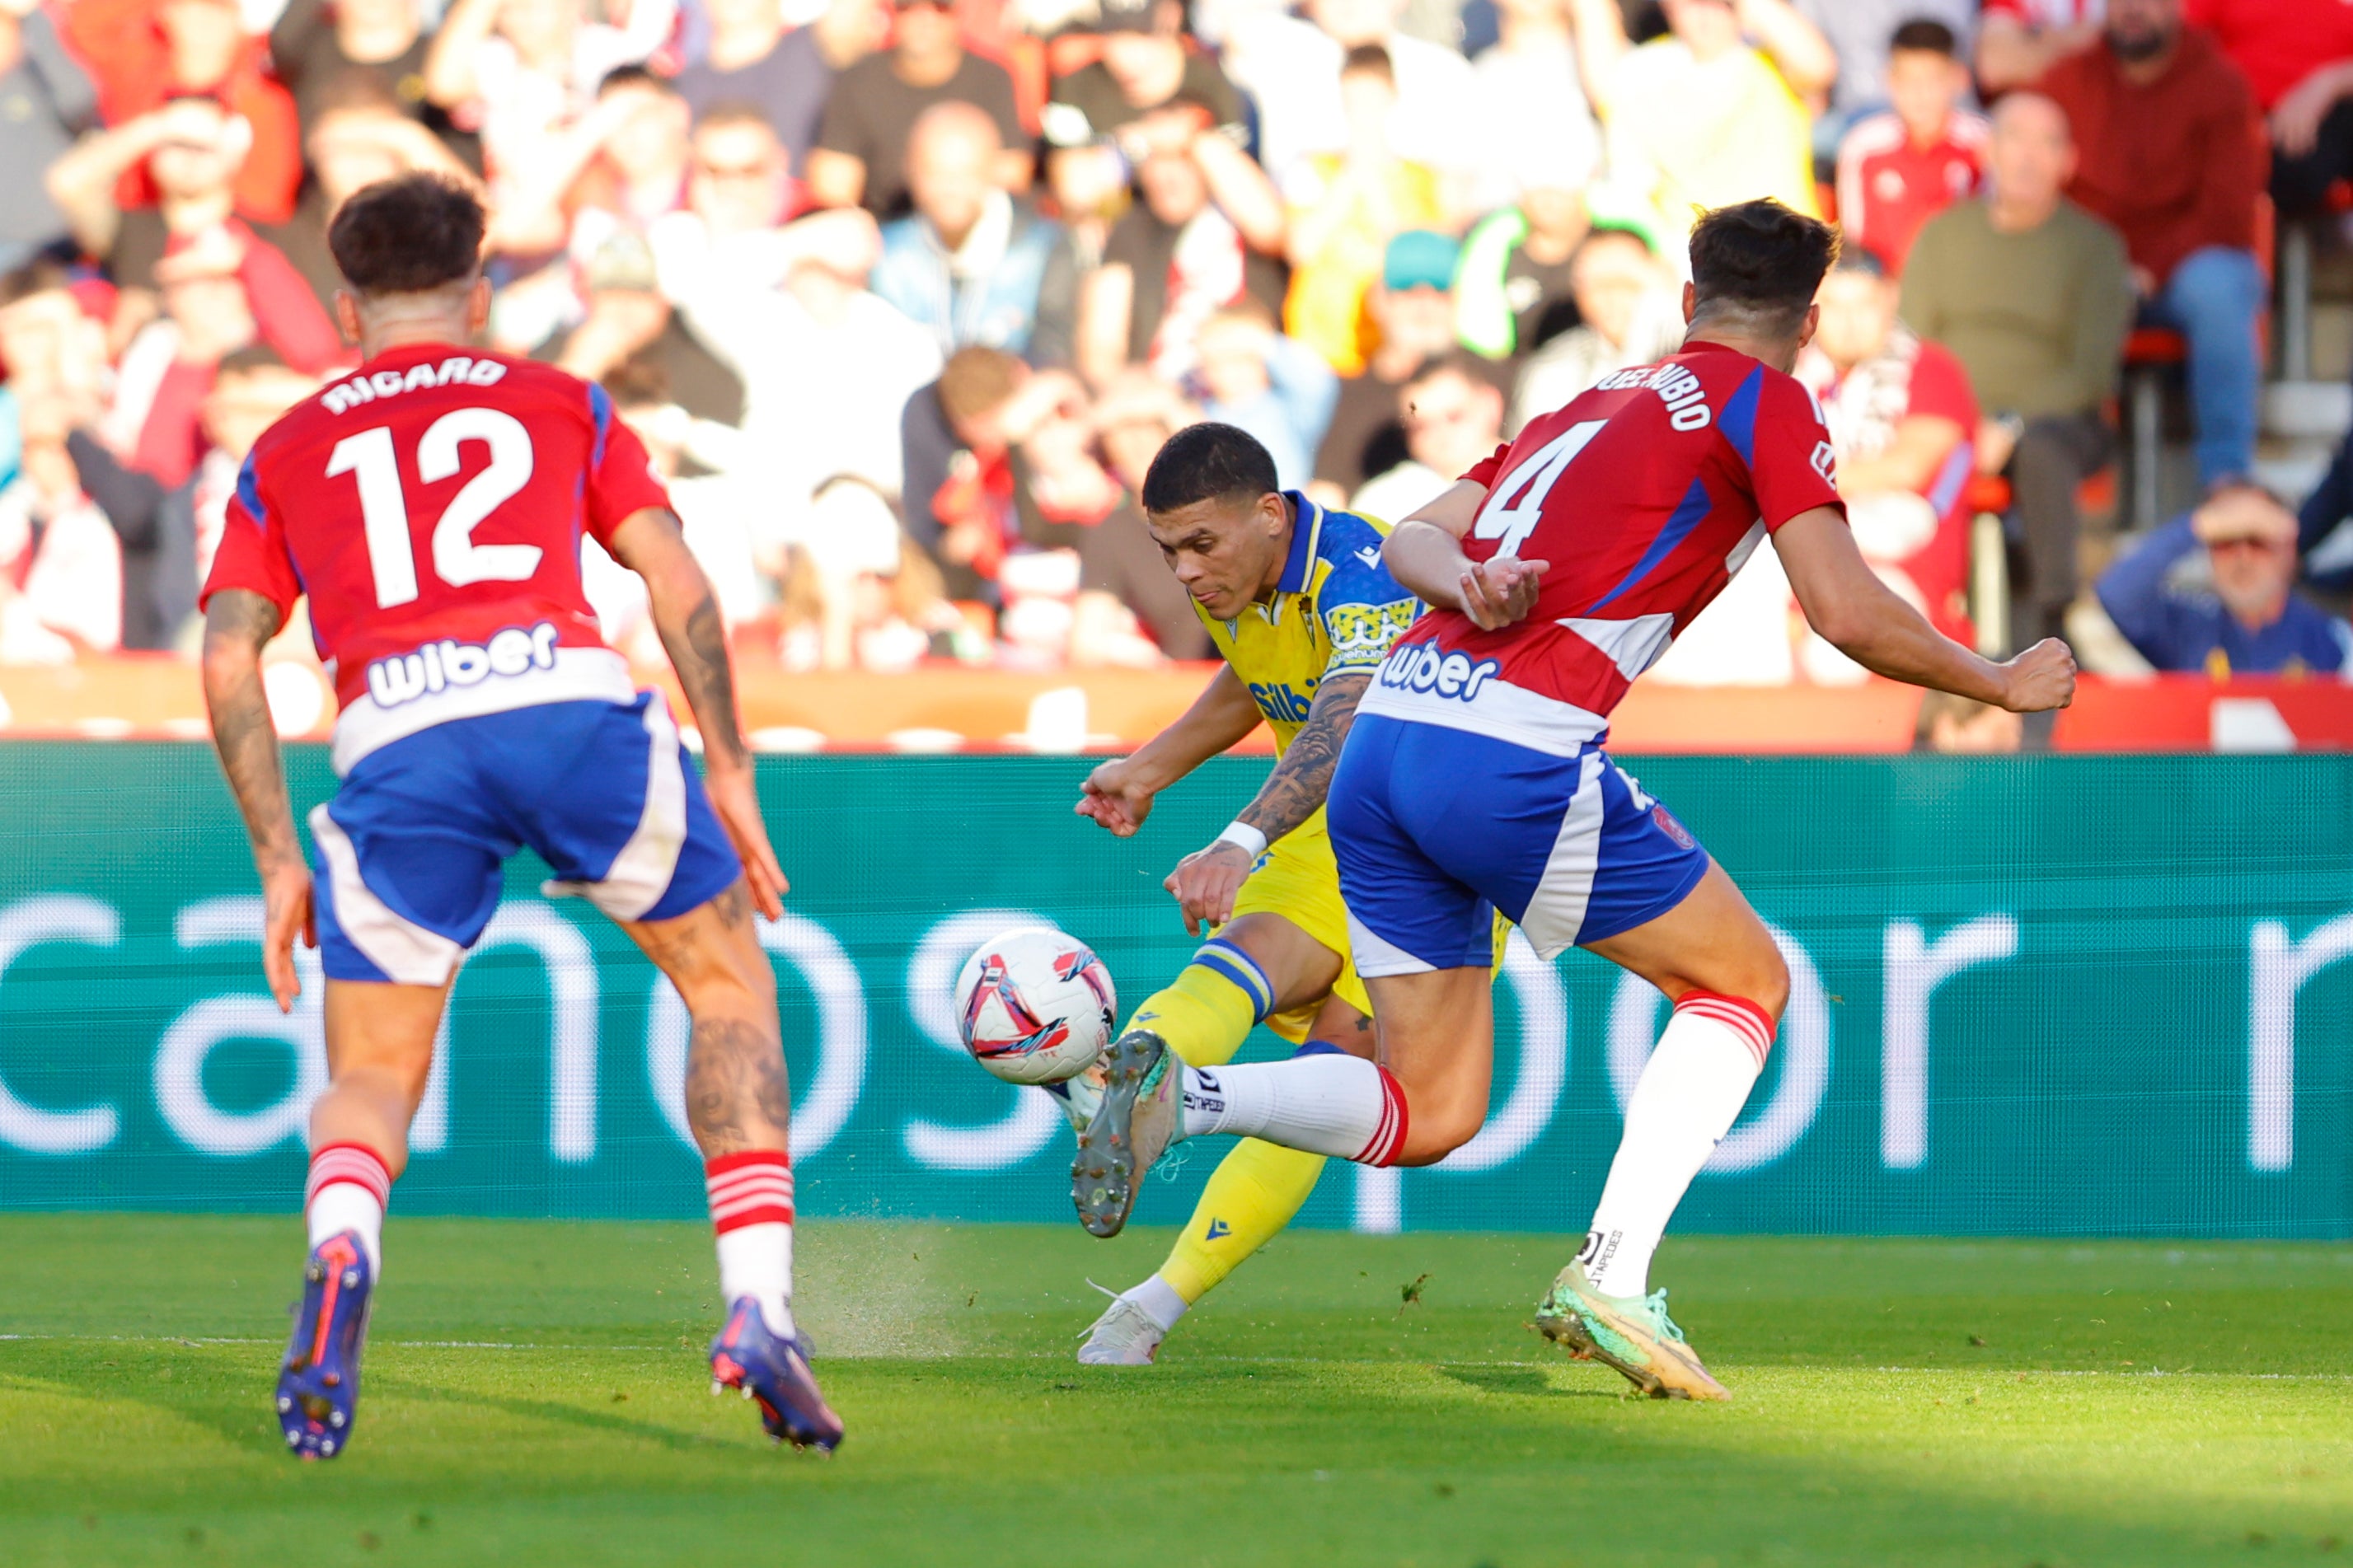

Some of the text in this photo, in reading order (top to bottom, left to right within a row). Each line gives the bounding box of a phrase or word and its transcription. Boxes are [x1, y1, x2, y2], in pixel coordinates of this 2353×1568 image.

[320, 356, 508, 415] RICARD
[1640, 363, 1712, 432] RUBIO
[324, 406, 544, 610] 12
[1474, 419, 1611, 557] 4
[368, 621, 559, 708] wiber
[1248, 676, 1320, 722] Silb
[1382, 638, 1498, 700] wiber
[0, 892, 1068, 1171] canos
